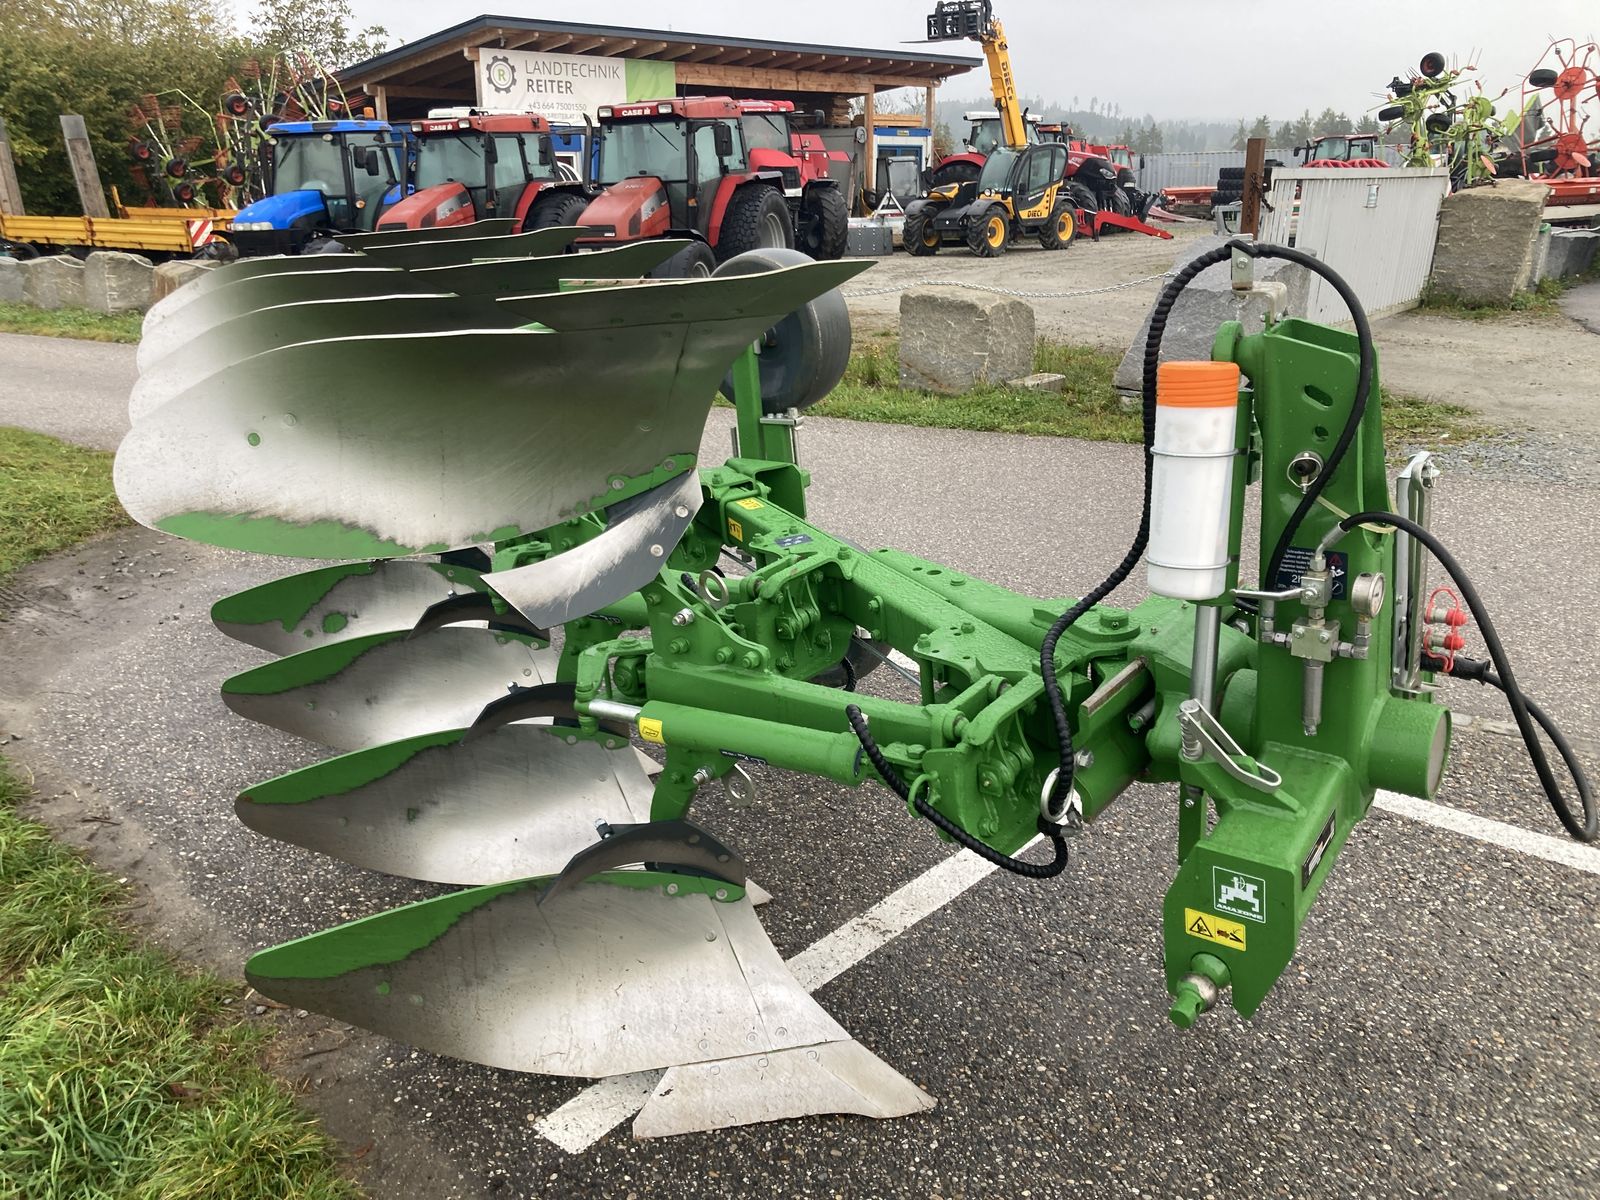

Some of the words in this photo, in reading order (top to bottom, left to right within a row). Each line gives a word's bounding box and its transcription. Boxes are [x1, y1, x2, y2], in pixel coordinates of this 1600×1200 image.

[498, 69, 506, 81] R
[525, 60, 620, 79] LANDTECHNIK
[527, 79, 574, 94] REITER
[528, 102, 541, 110] +43
[542, 102, 555, 110] 664
[556, 102, 587, 111] 75001550
[621, 109, 643, 117] CASE
[1027, 210, 1043, 218] DIECI
[1217, 903, 1263, 920] AMAZONE
